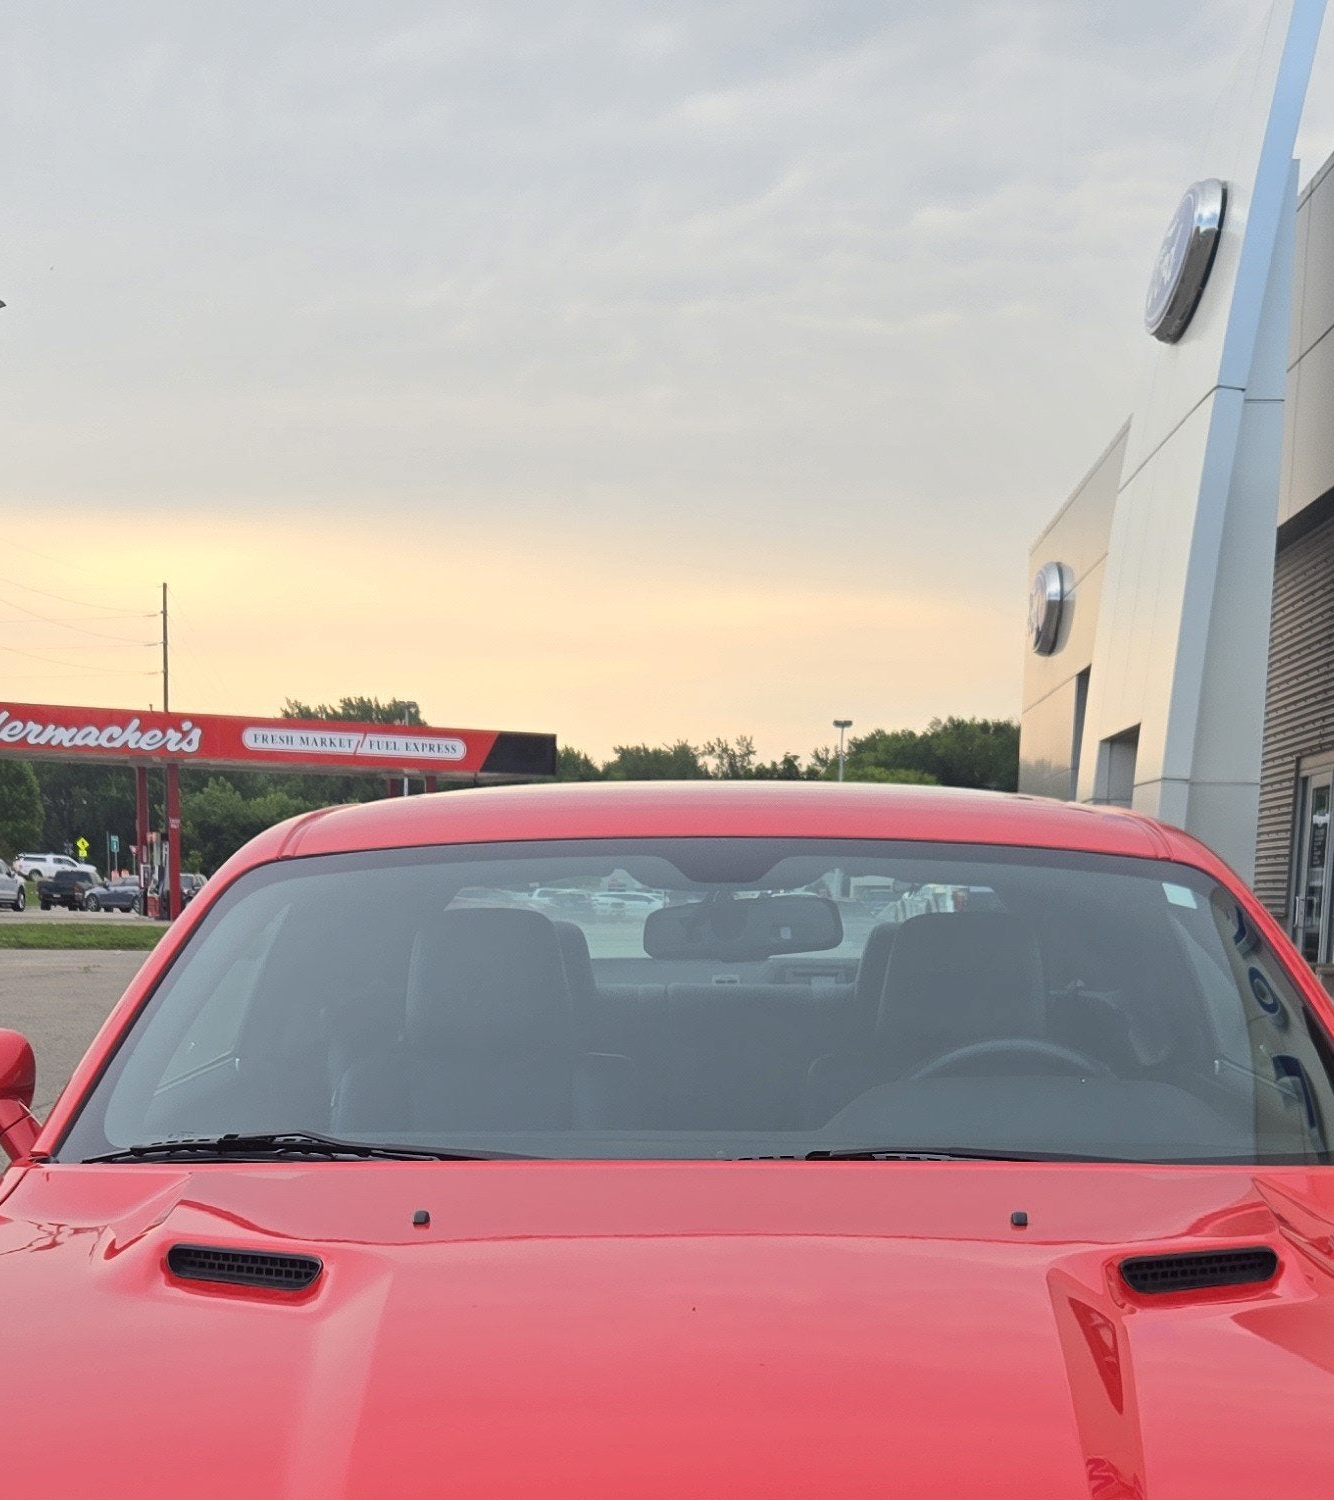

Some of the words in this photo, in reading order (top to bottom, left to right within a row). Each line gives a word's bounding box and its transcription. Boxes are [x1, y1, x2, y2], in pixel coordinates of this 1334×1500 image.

[253, 732, 295, 746] FRESH
[299, 736, 354, 749] MARKET
[369, 739, 401, 751] FUEL
[405, 742, 458, 755] EXPRESS
